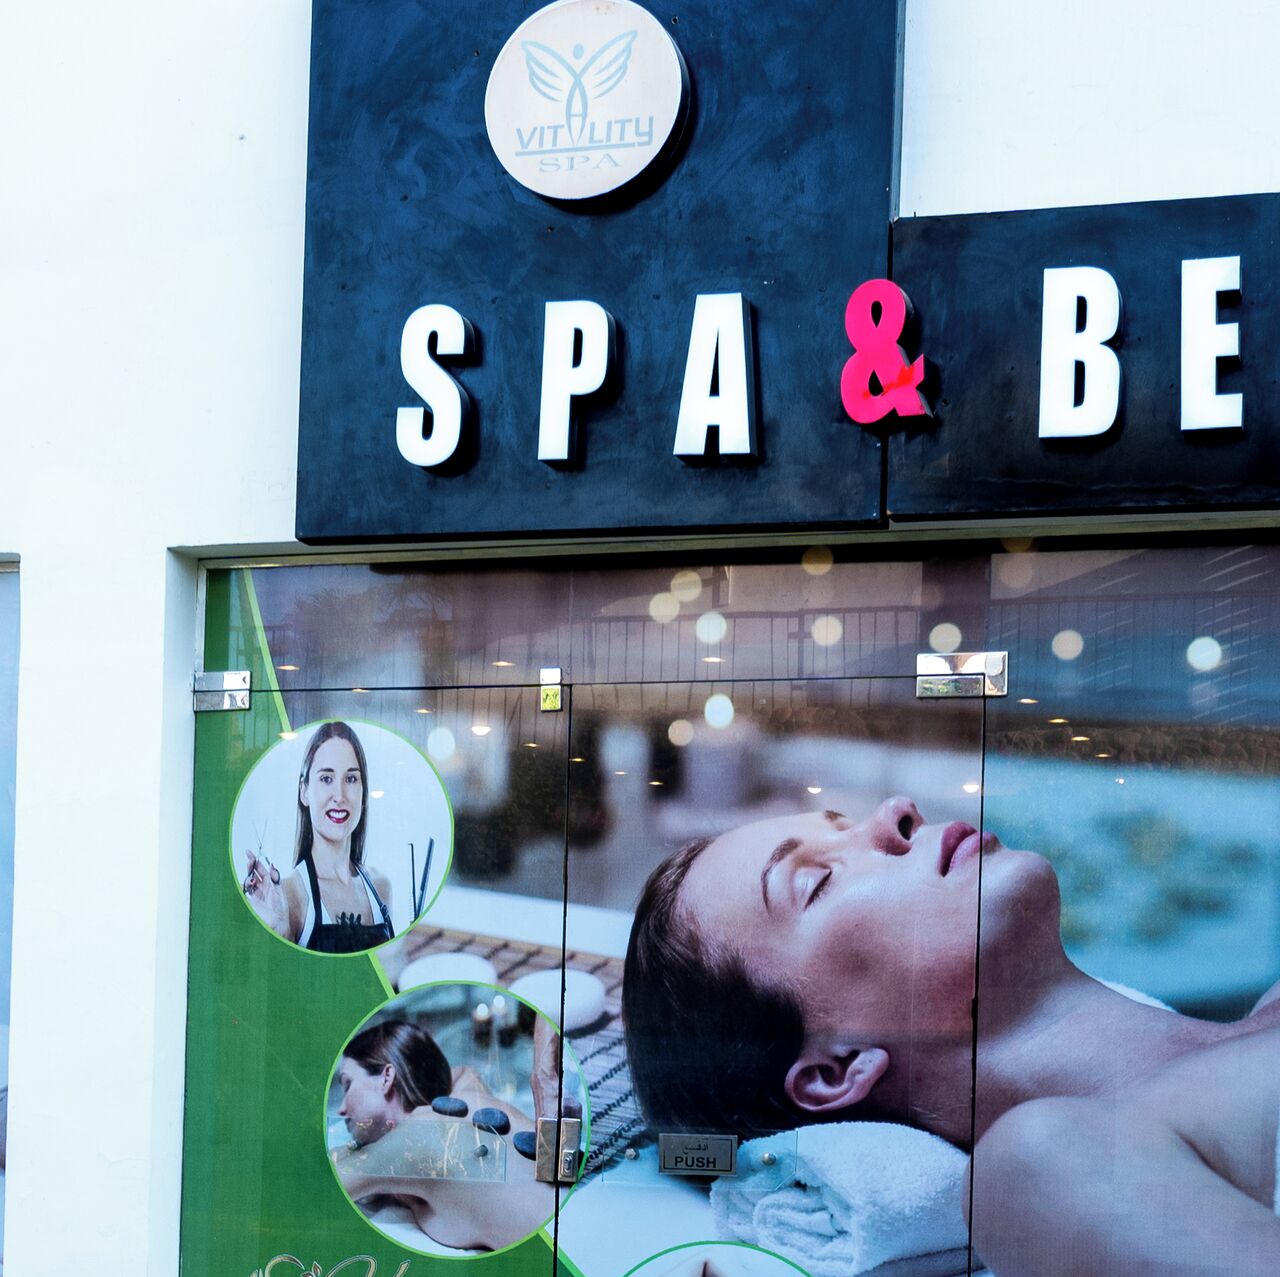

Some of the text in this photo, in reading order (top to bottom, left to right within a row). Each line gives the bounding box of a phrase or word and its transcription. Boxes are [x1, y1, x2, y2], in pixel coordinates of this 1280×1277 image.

[515, 114, 654, 150] VITALITY
[538, 152, 622, 173] SPA
[395, 291, 754, 467] SPA
[839, 277, 926, 425] &
[674, 1156, 717, 1169] PUSH
